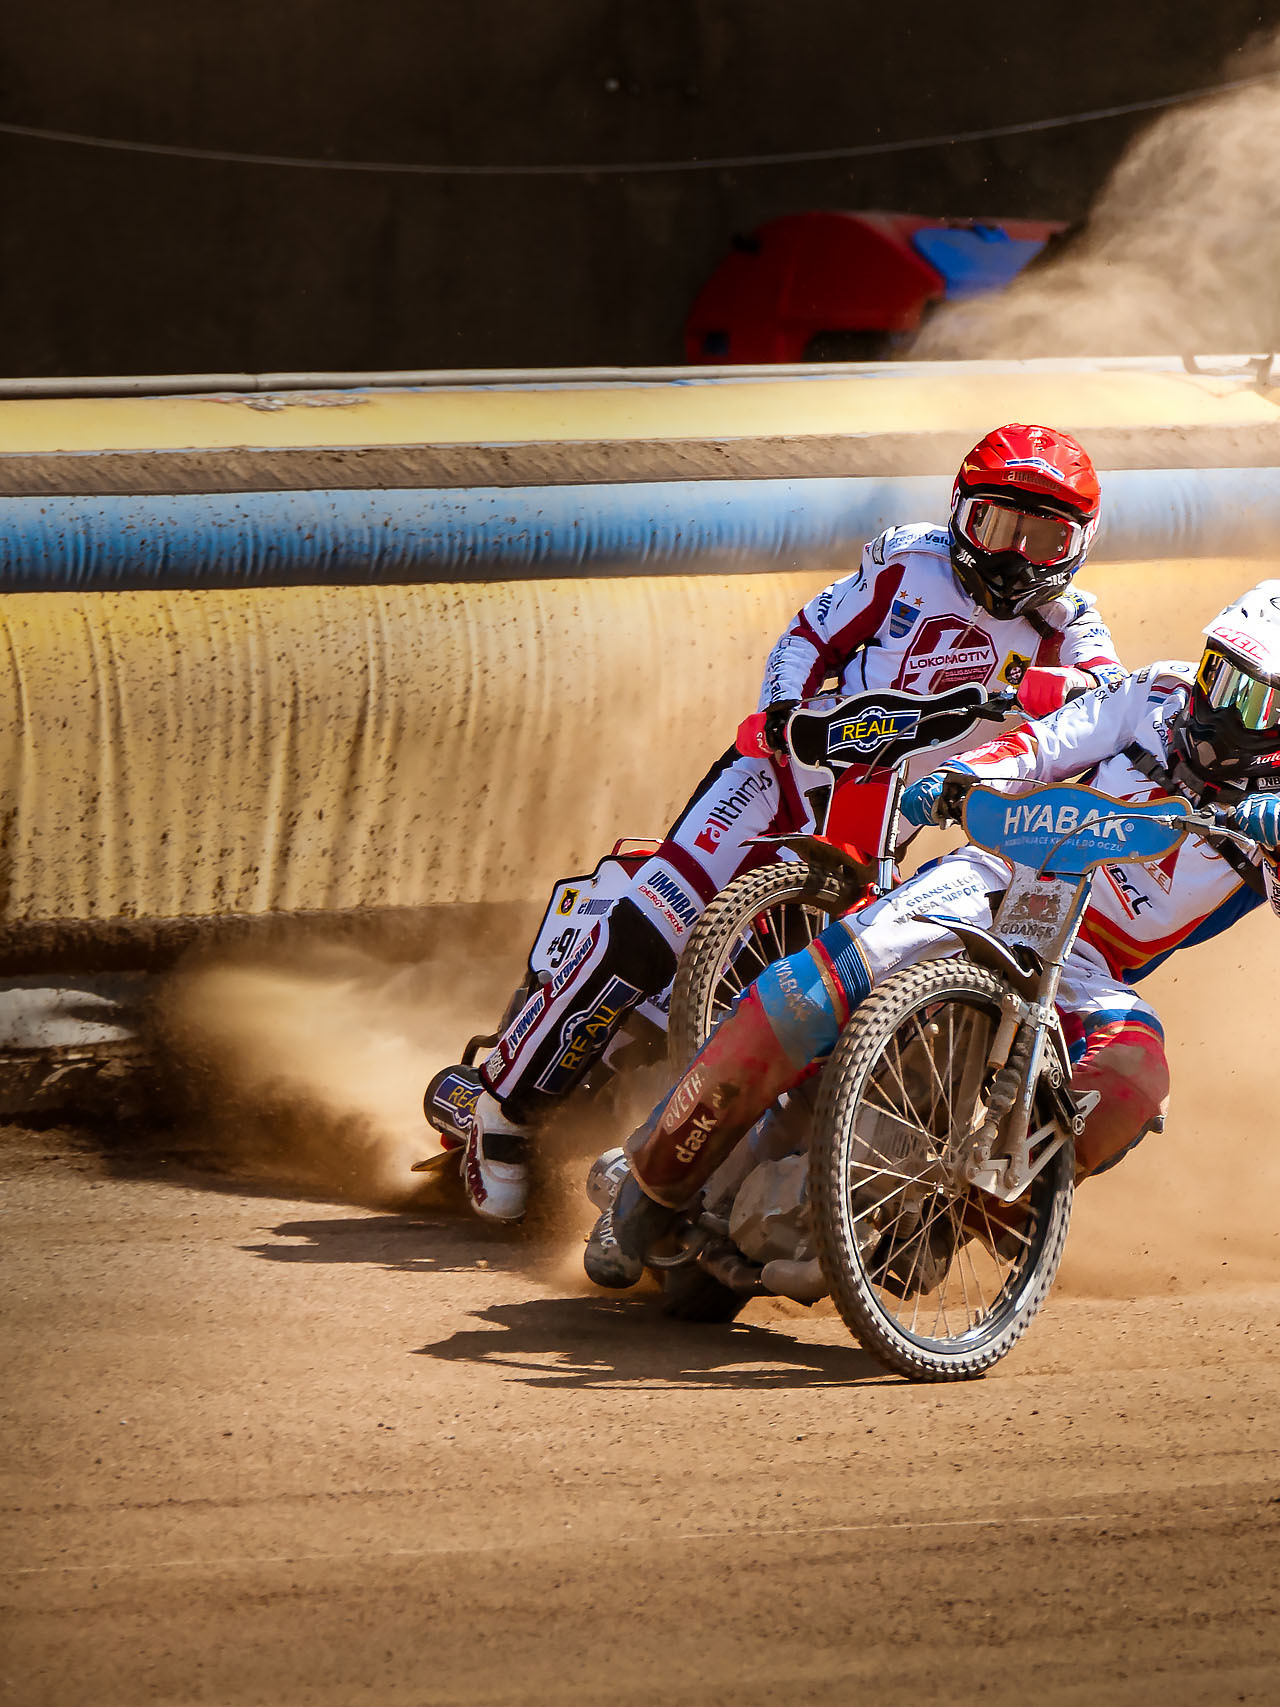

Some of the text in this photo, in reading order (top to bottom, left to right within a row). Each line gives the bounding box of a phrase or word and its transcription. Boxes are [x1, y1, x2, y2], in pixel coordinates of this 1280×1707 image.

[925, 533, 951, 546] Valu
[910, 650, 990, 670] LOKOMOTIV
[842, 719, 898, 741] REALL
[560, 1005, 621, 1070] REALL
[448, 1086, 479, 1114] REA
